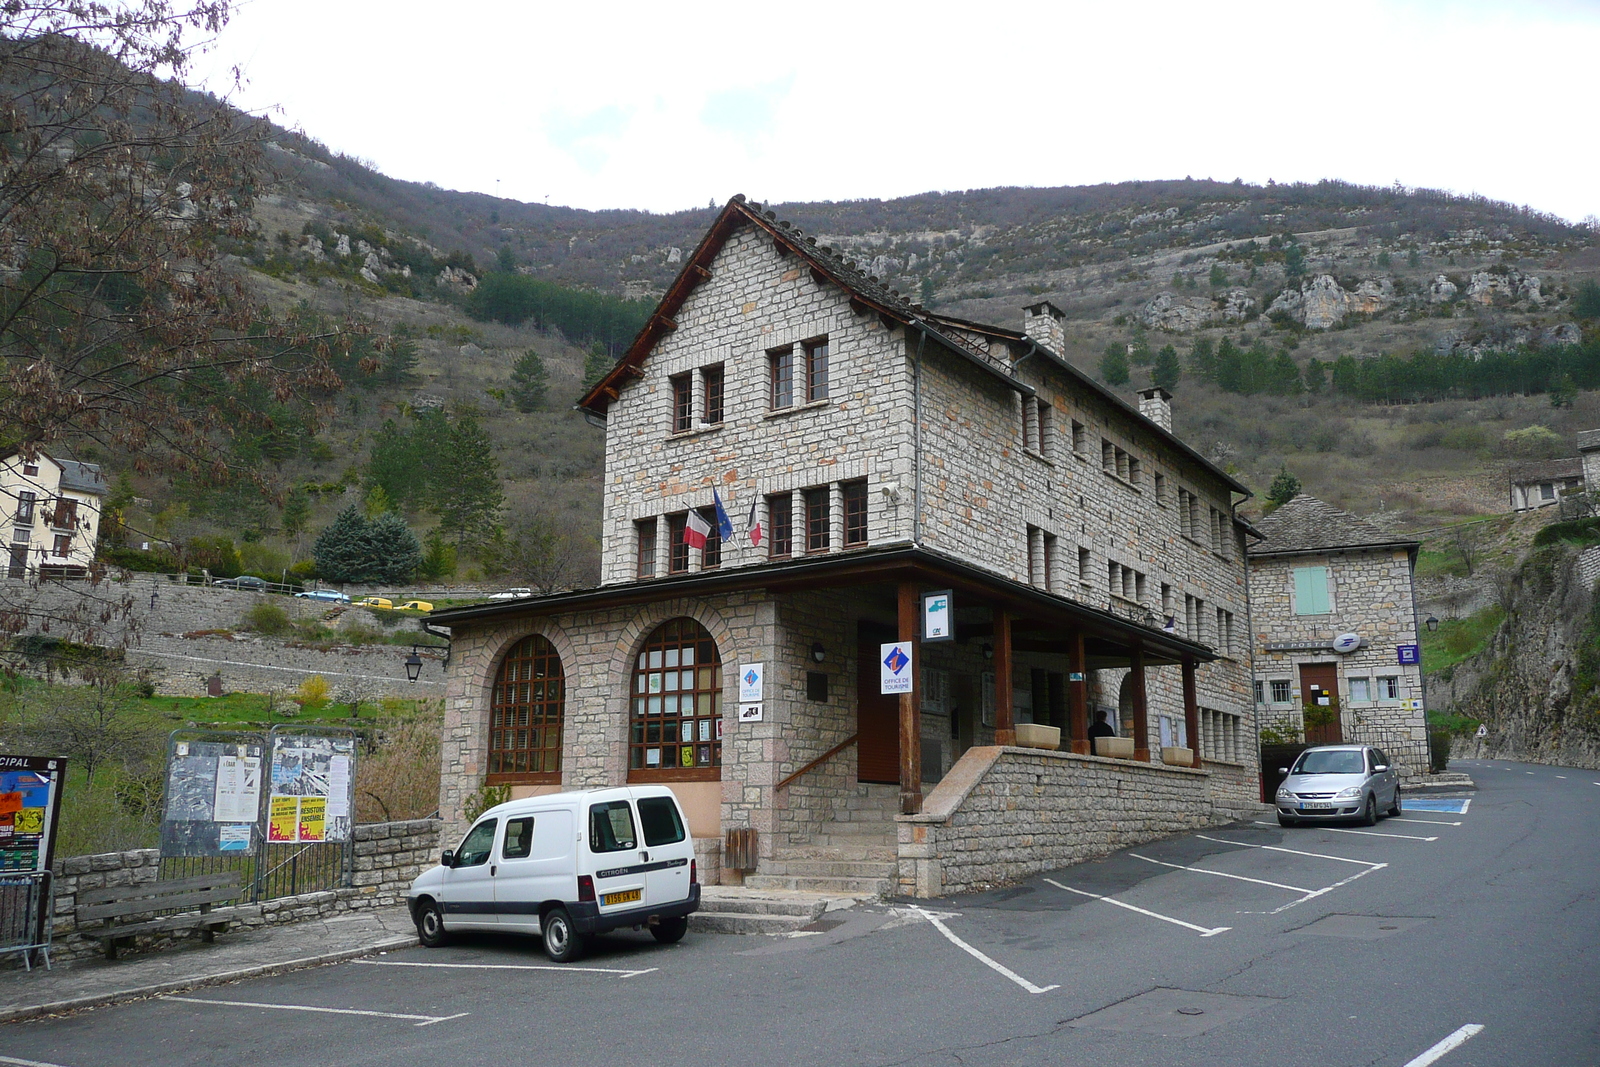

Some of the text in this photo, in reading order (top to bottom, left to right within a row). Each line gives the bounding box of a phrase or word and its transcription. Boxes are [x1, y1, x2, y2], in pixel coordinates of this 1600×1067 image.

[301, 806, 325, 814] RÉSISTONS
[301, 814, 324, 822] ENSEMBLE
[601, 868, 628, 876] CITROËN
[606, 893, 621, 904] 8156
